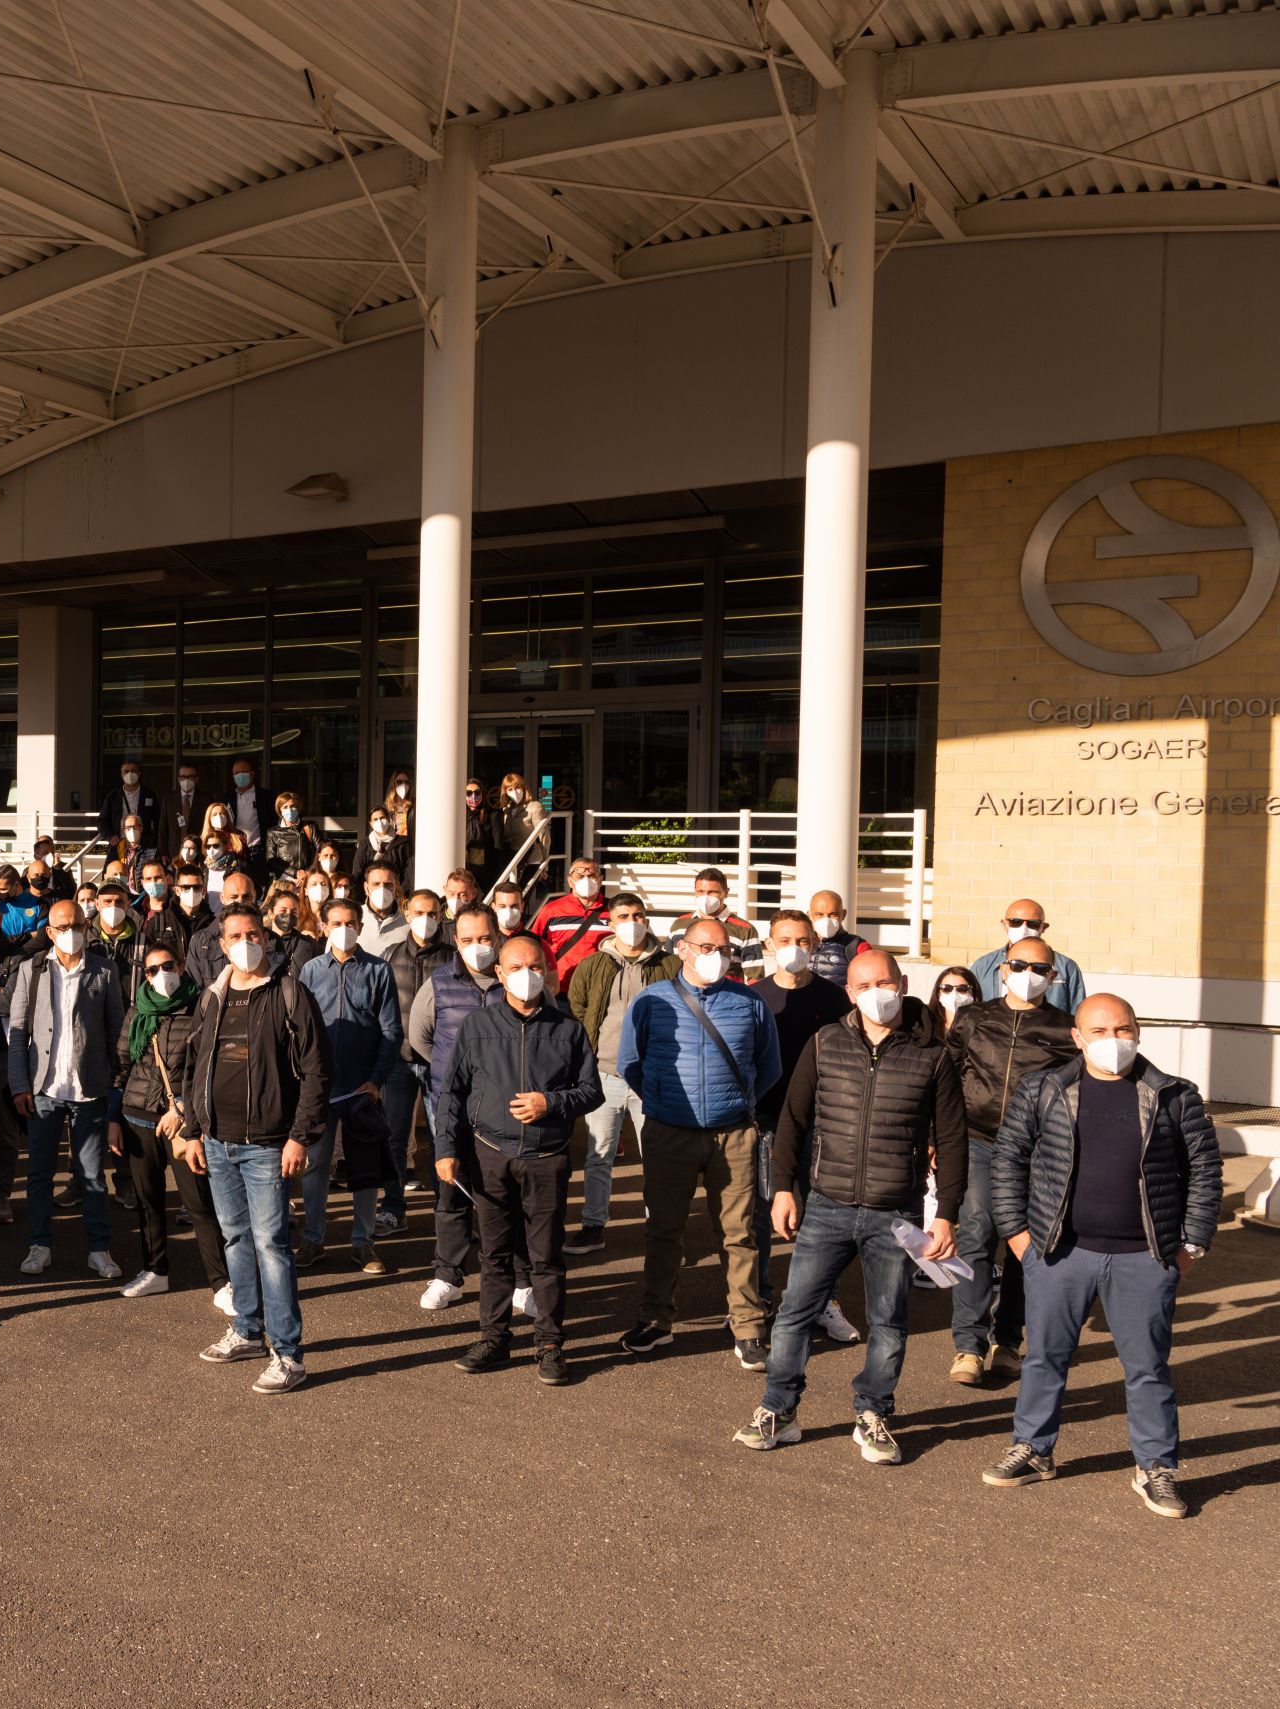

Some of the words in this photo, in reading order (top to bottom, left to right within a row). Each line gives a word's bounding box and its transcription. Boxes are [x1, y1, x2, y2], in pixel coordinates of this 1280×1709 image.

[1027, 694, 1154, 729] Cagliari
[1076, 737, 1208, 760] SOGAER
[974, 790, 1139, 817] Aviazione
